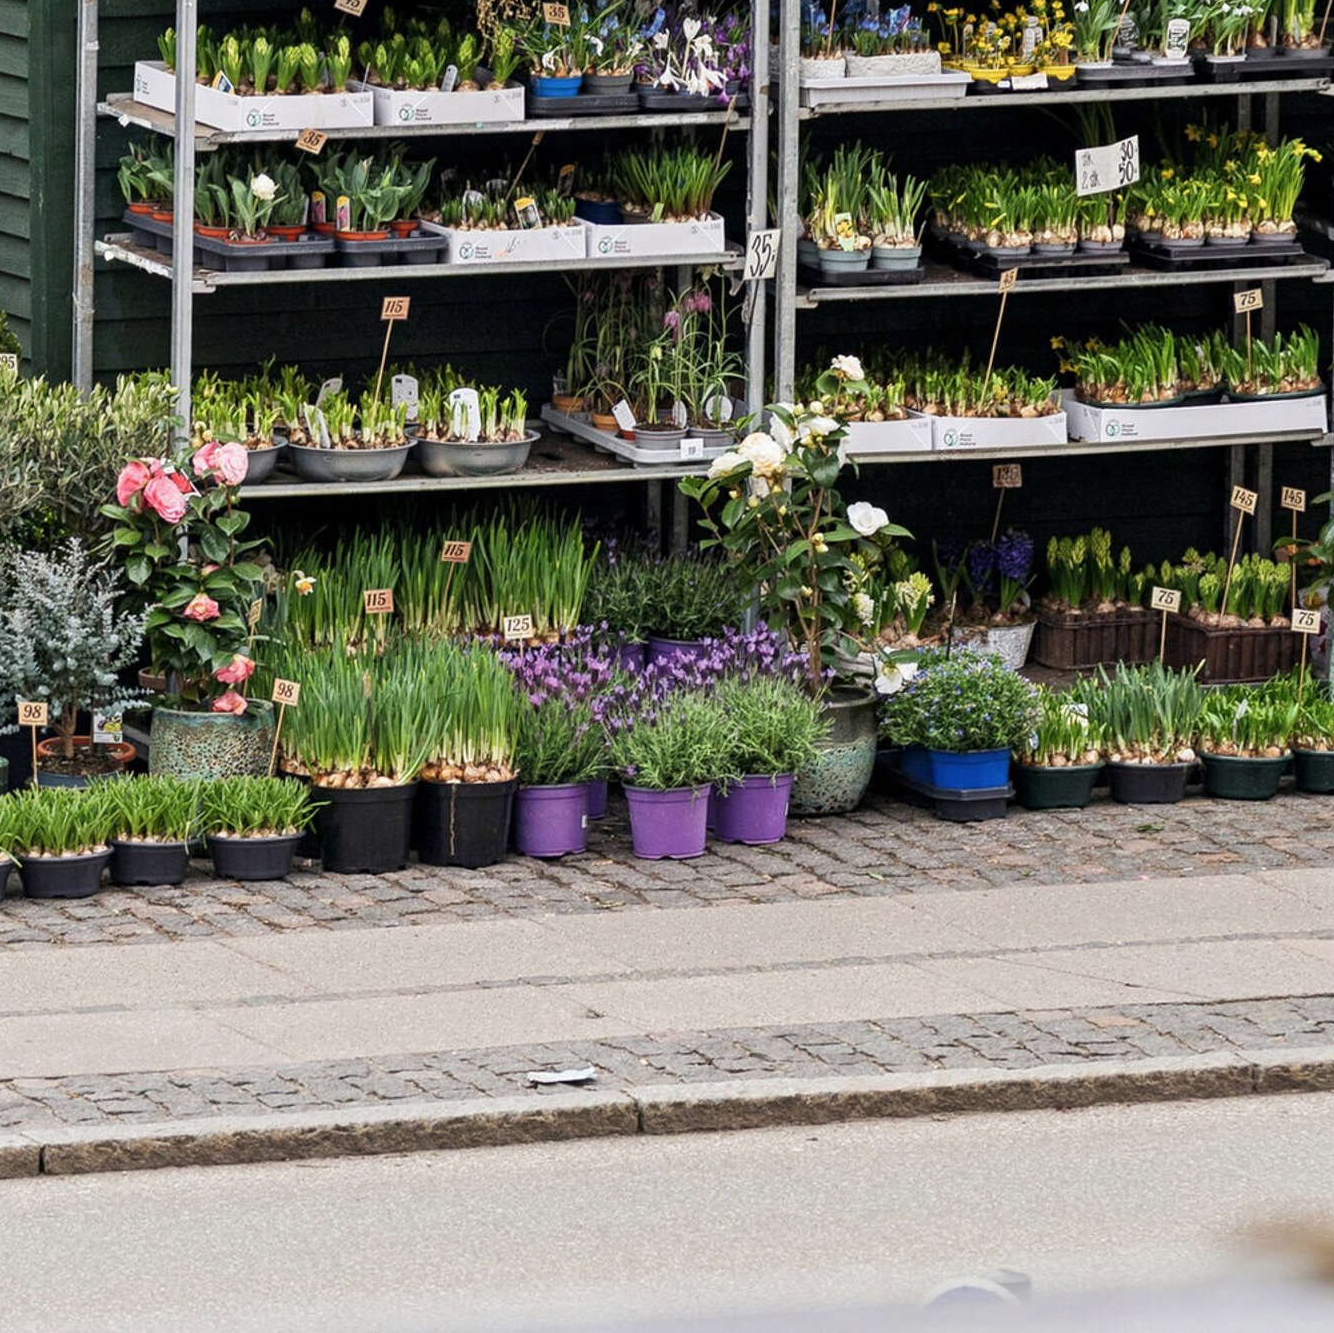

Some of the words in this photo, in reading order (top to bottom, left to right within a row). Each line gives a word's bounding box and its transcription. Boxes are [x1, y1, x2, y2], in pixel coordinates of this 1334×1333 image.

[549, 5, 565, 19] 35
[303, 131, 323, 147] 35
[1240, 292, 1256, 306] 75
[384, 300, 404, 314] 115
[1234, 489, 1254, 507] 145
[1284, 489, 1302, 505] 145
[444, 544, 465, 557] 115
[366, 592, 386, 607] 115
[1159, 590, 1175, 603] 75
[507, 617, 530, 632] 125
[1298, 612, 1315, 626] 75
[277, 681, 294, 698] 98
[24, 704, 42, 719] 98
